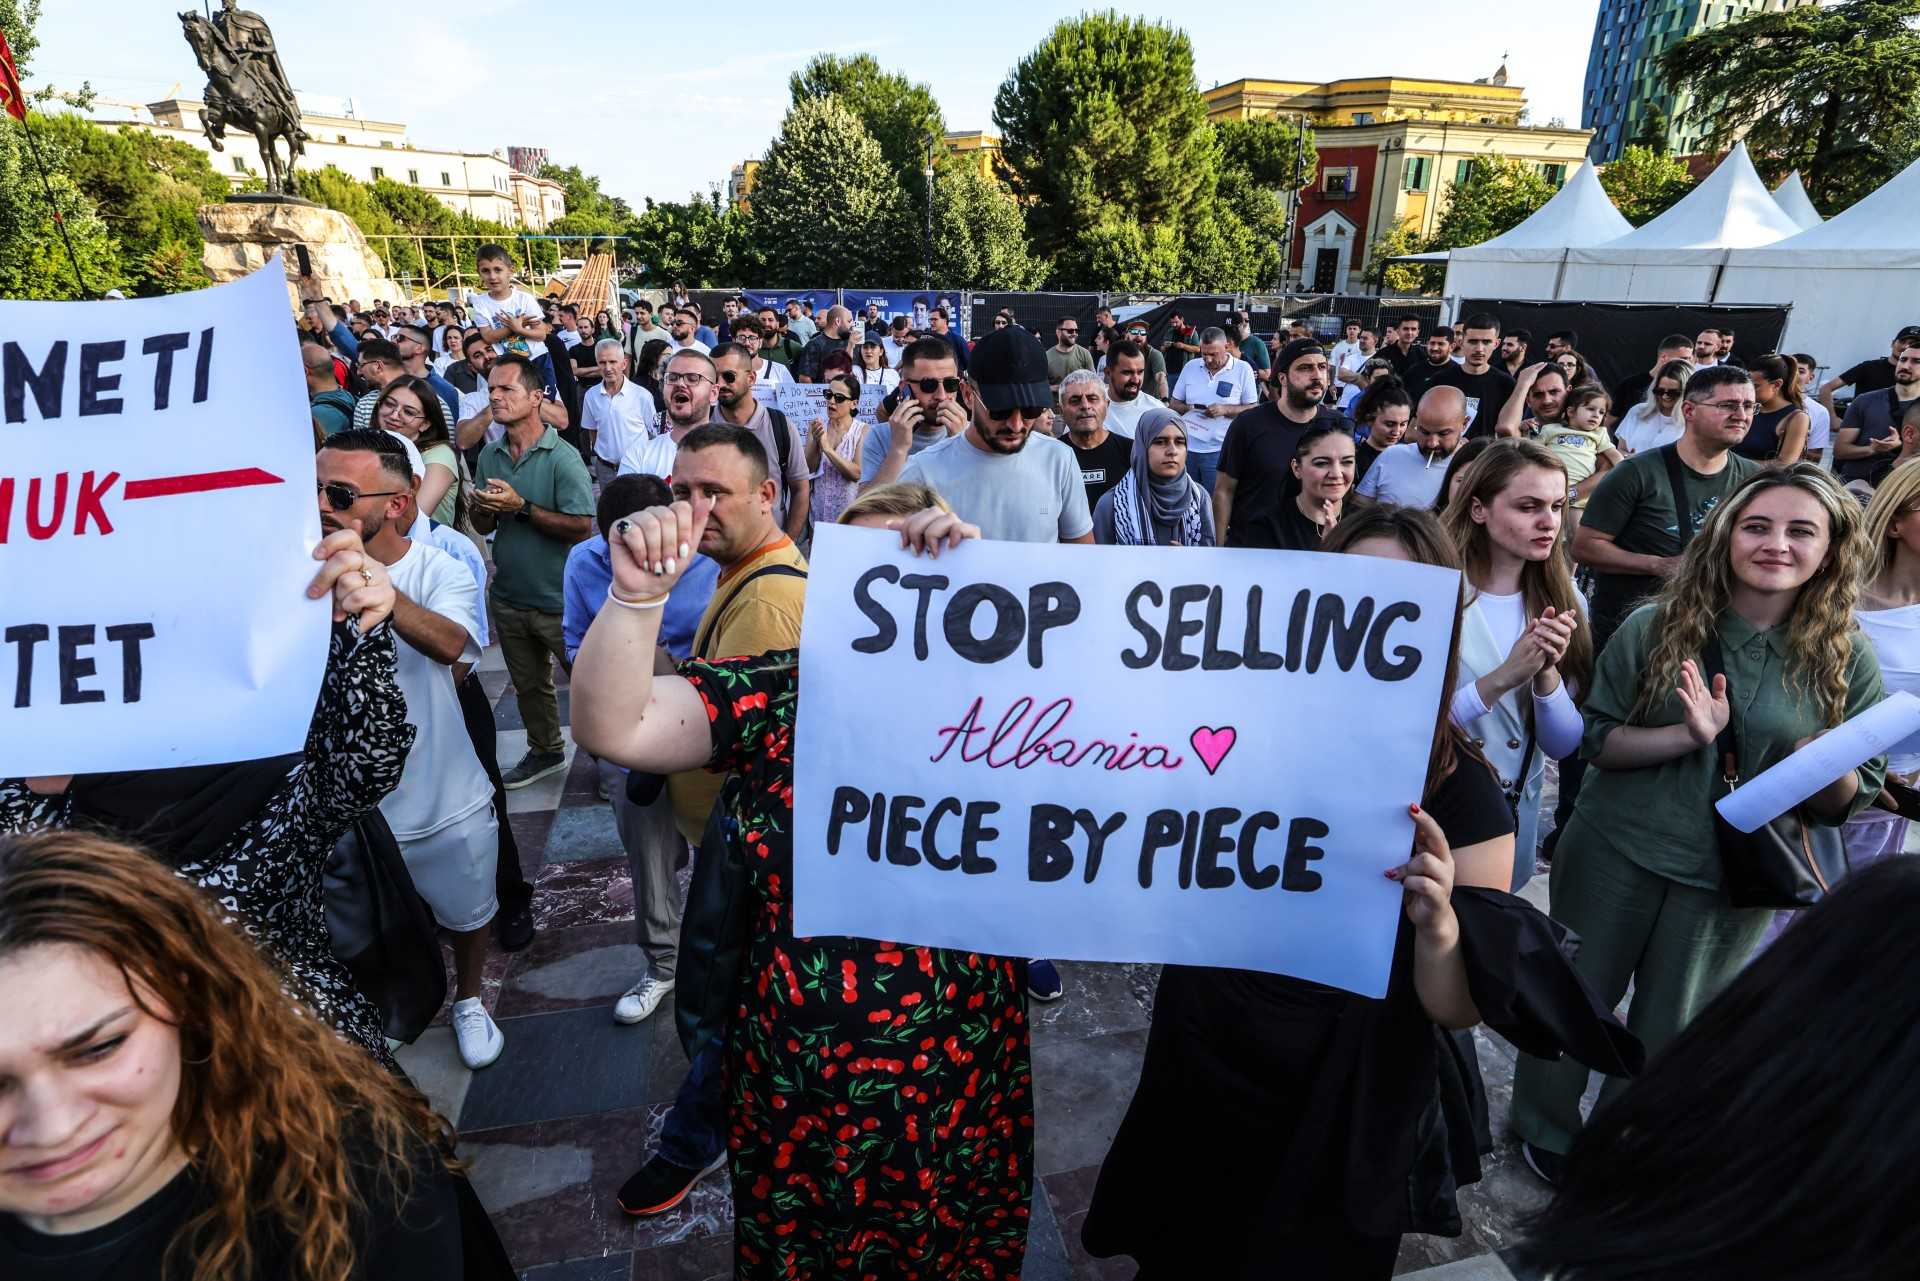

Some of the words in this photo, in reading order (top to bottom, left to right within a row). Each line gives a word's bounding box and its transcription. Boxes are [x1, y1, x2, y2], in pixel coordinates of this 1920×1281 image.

[3, 327, 214, 424] NETI
[5, 623, 155, 708] TET
[851, 565, 1081, 669] STOP
[1121, 581, 1422, 681] SELLING
[930, 697, 1183, 770] Albania
[827, 786, 1000, 875] PIECE
[1028, 803, 1127, 884] BY
[1138, 807, 1330, 894] PIECE
